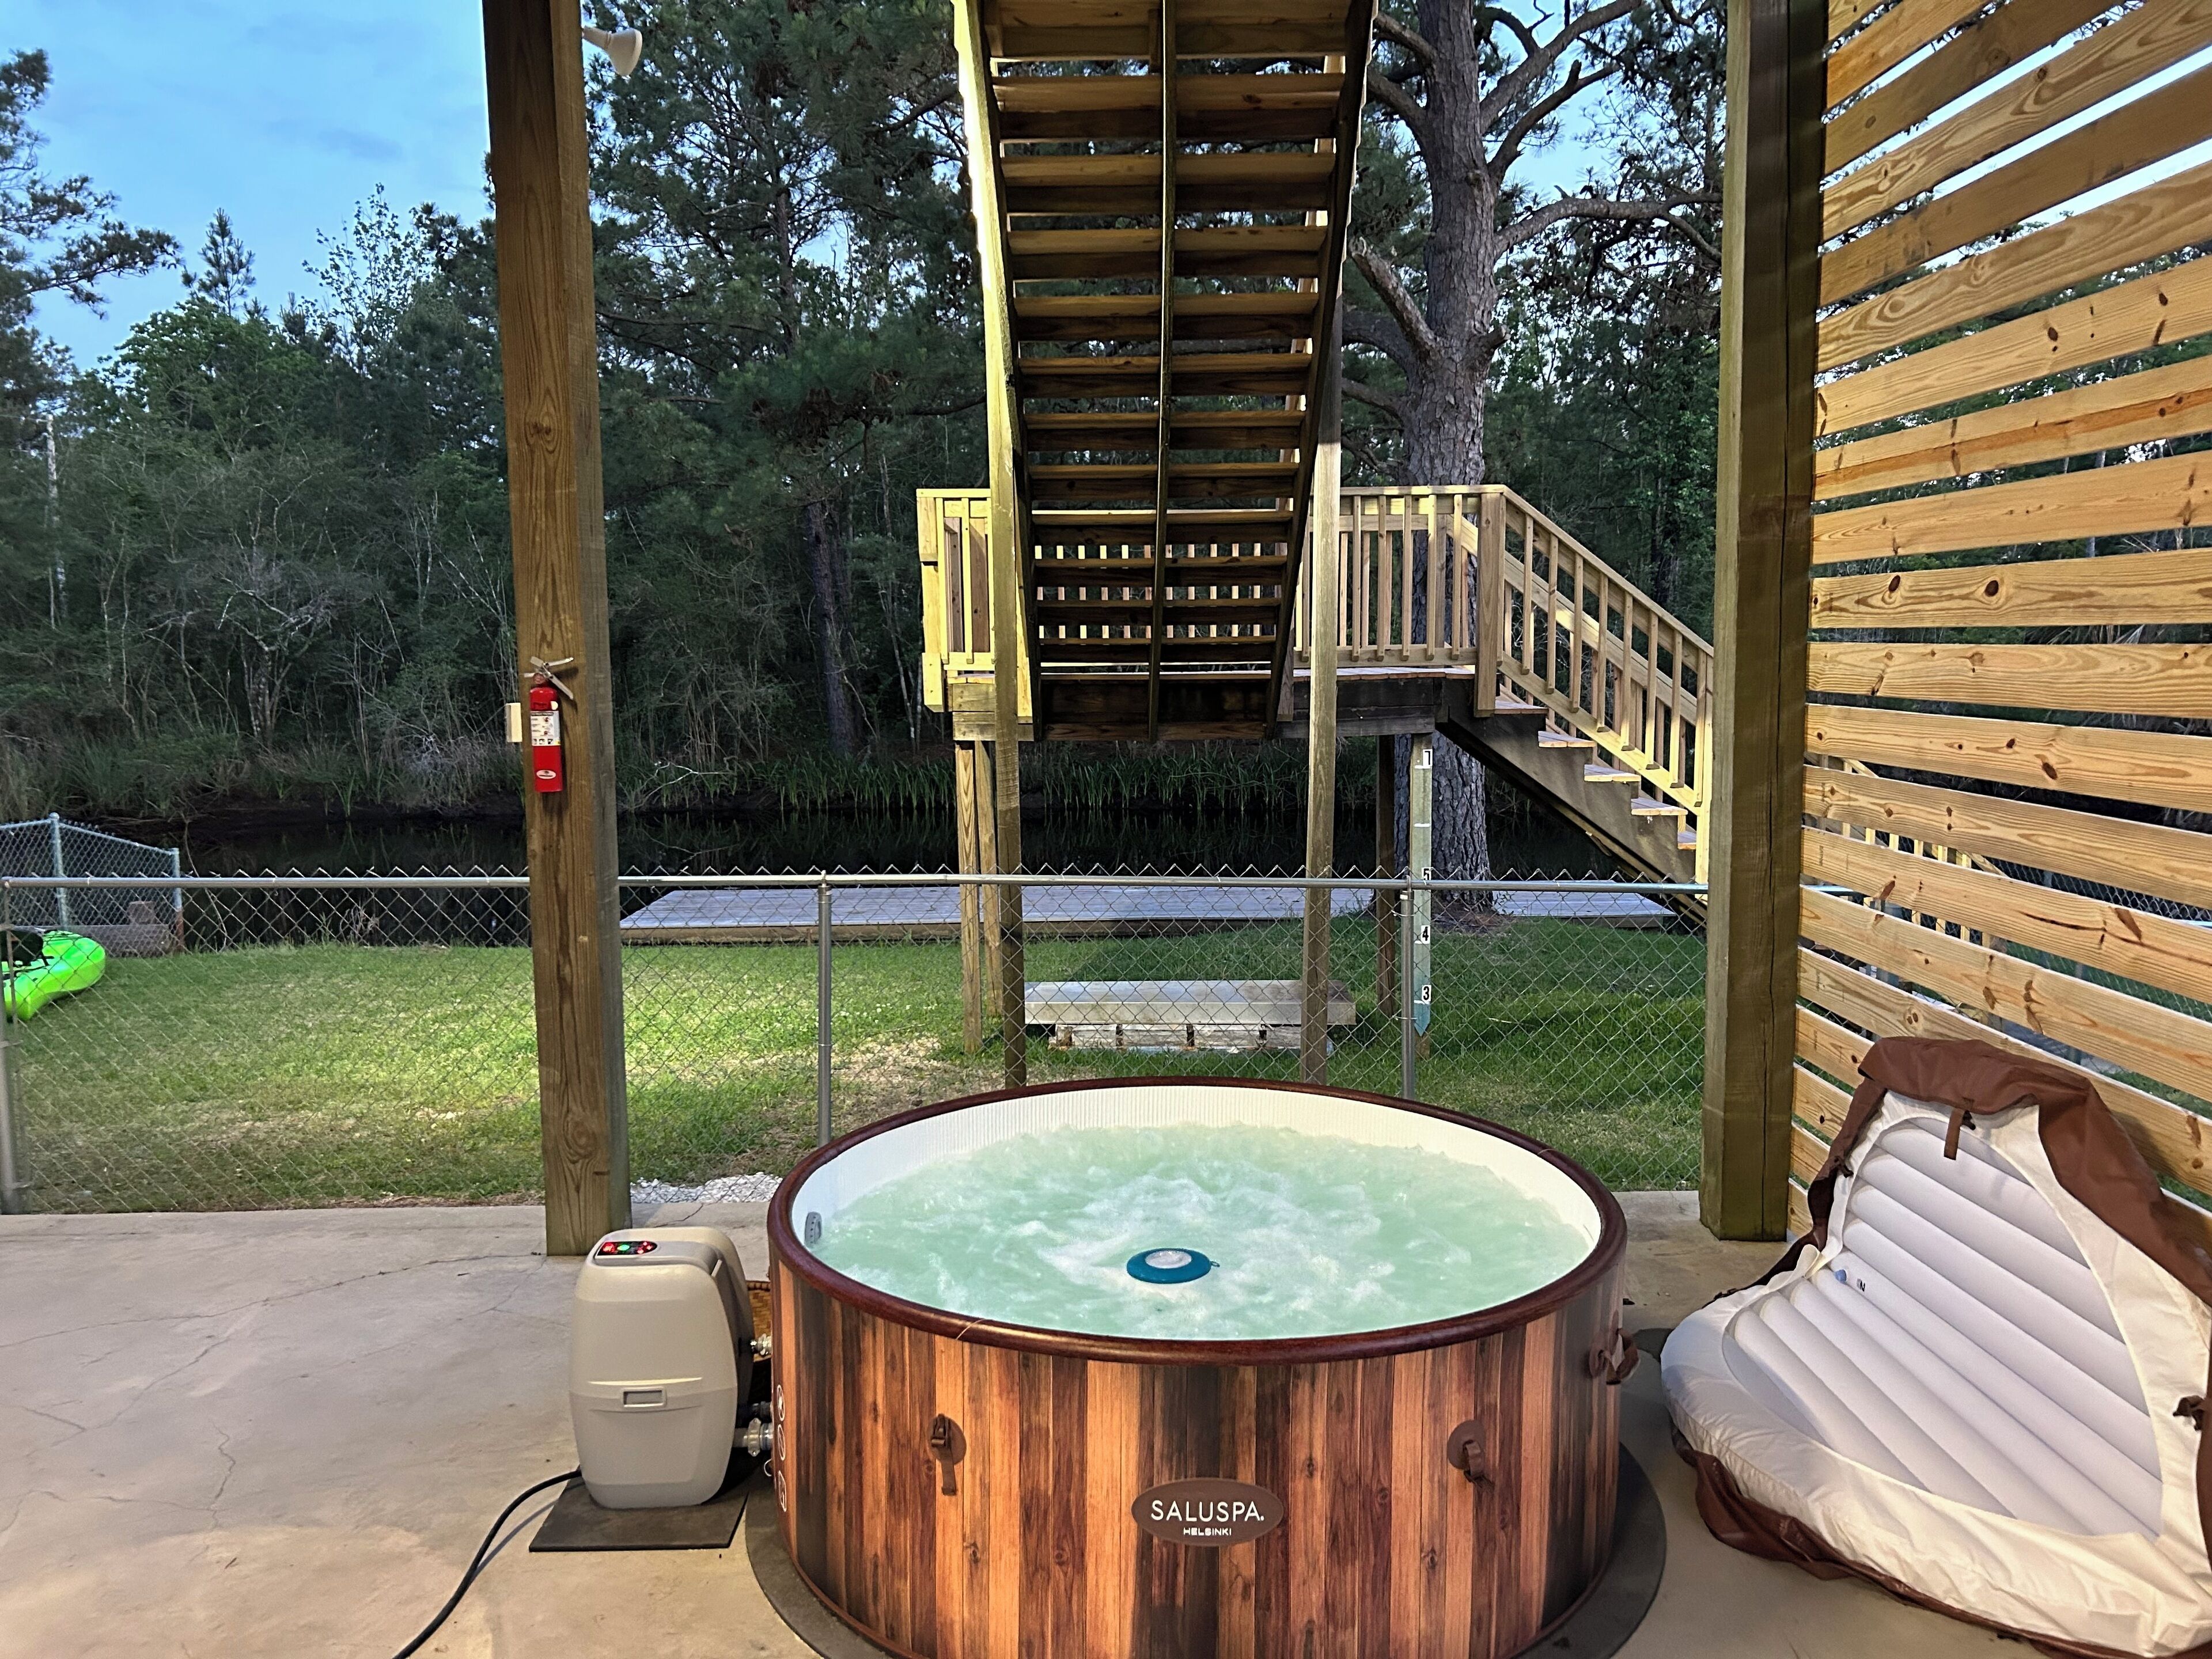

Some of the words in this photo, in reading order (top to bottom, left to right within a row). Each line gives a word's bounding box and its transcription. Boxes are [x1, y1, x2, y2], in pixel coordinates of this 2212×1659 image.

[1424, 751, 1431, 766] 7
[1422, 926, 1429, 941] 4
[1423, 986, 1430, 1001] 3
[1183, 1527, 1232, 1536] HELSINKI
